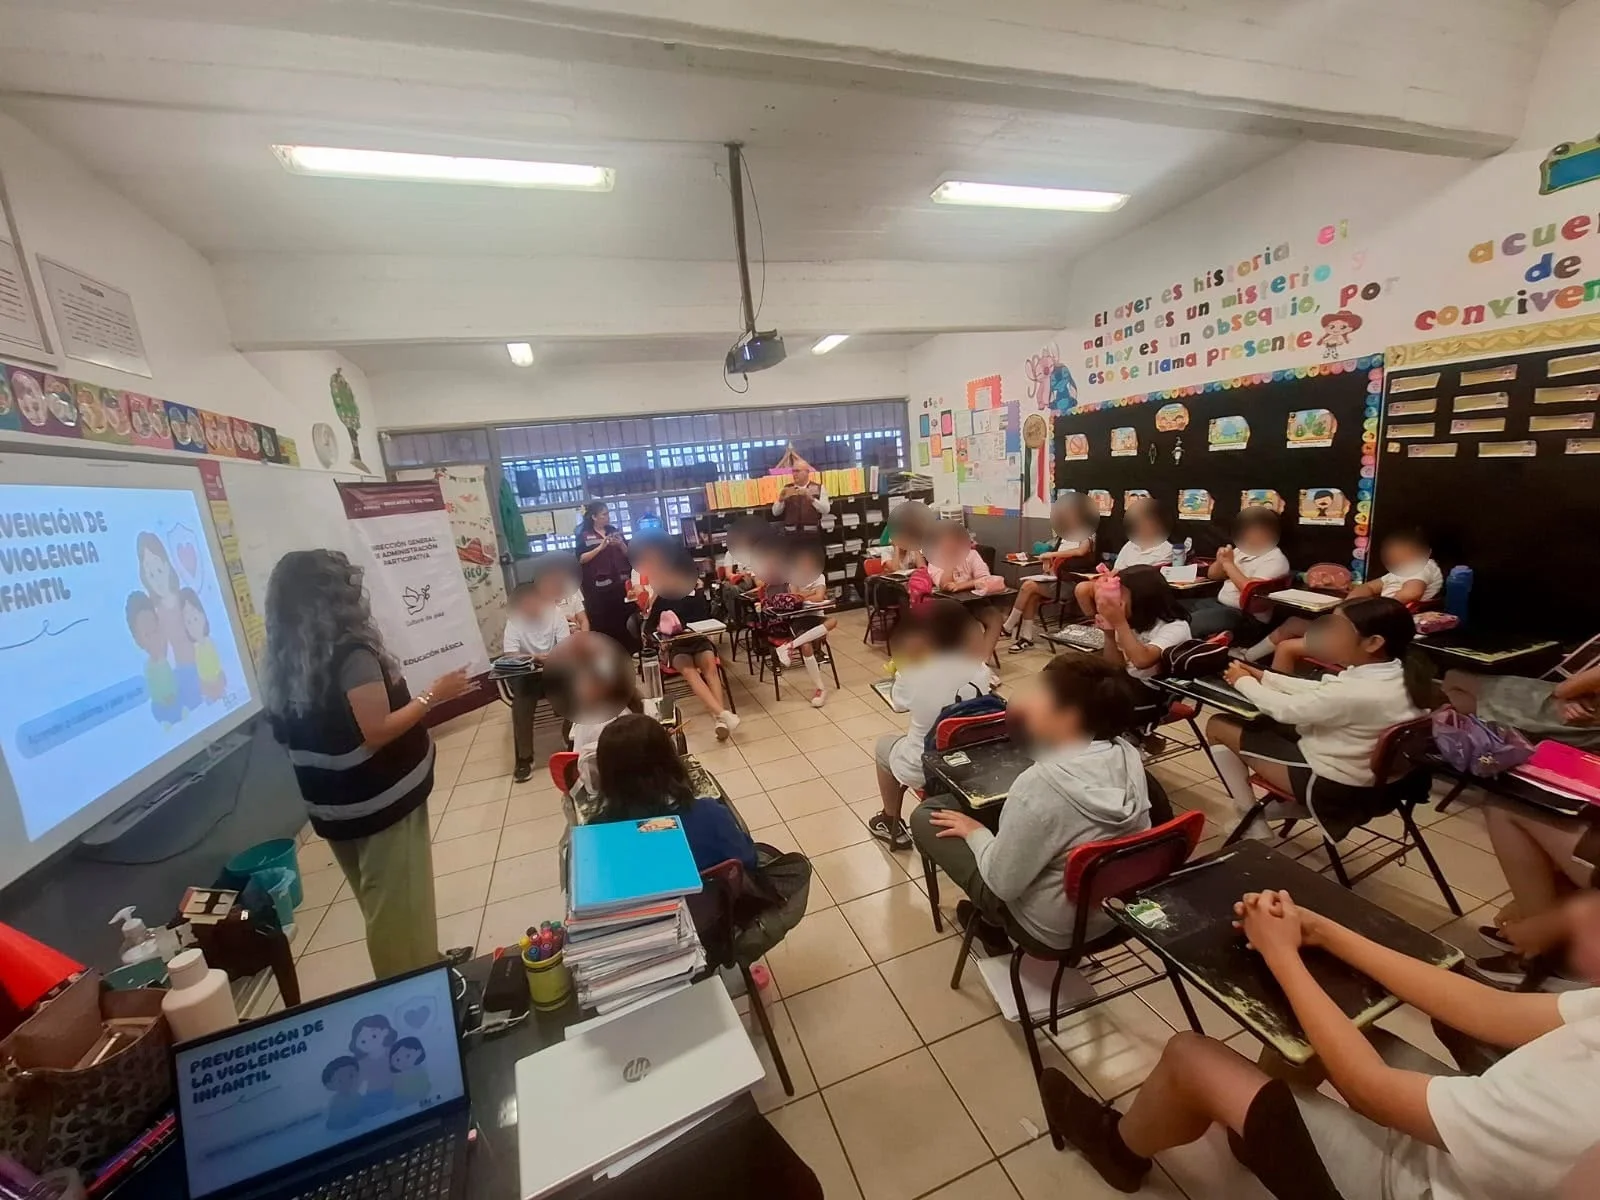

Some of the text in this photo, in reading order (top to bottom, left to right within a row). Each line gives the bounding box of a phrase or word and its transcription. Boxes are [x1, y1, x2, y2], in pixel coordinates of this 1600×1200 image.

[1468, 212, 1600, 264] acue
[1094, 311, 1107, 327] El
[1114, 297, 1152, 318] ayer
[1161, 284, 1182, 303] es
[1193, 242, 1290, 293] historia
[1525, 252, 1581, 282] de
[1085, 355, 1099, 368] el
[1139, 339, 1158, 355] es
[1169, 332, 1190, 347] un
[1339, 276, 1400, 308] por
[1154, 311, 1174, 328] es
[1186, 302, 1210, 320] un
[1221, 264, 1331, 308] misterio
[1088, 331, 1312, 384] eso se llama presente
[83, 511, 107, 533] DE
[0, 541, 99, 575] VIOLENCIA
[190, 1020, 324, 1074] PREVENCIÓN DE
[191, 1041, 307, 1089] LA VIOLENCIA
[193, 1070, 271, 1104] INFANTIL
